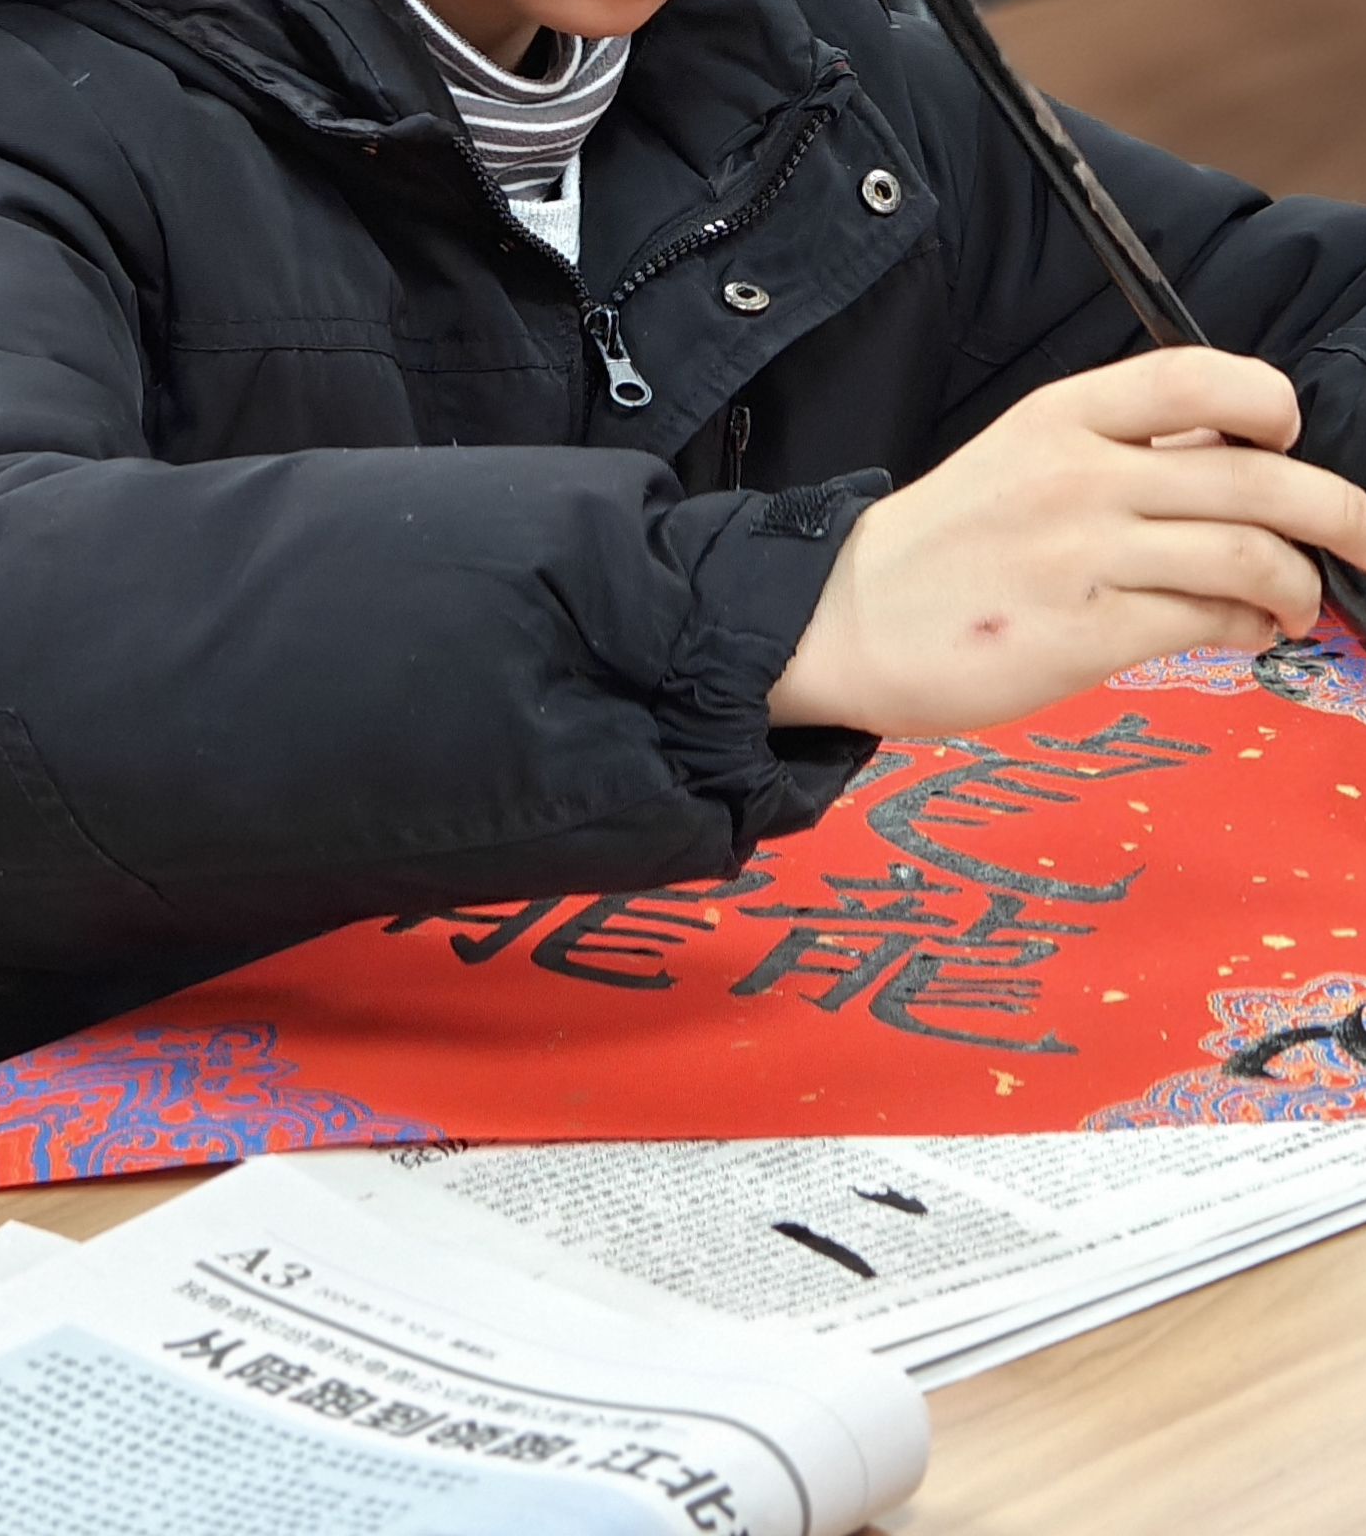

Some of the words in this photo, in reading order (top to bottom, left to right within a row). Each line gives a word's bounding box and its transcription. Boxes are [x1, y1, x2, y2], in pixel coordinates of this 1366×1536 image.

[215, 1246, 313, 1290] A3
[162, 1327, 753, 1536] 从陪跑到领跑，江北
